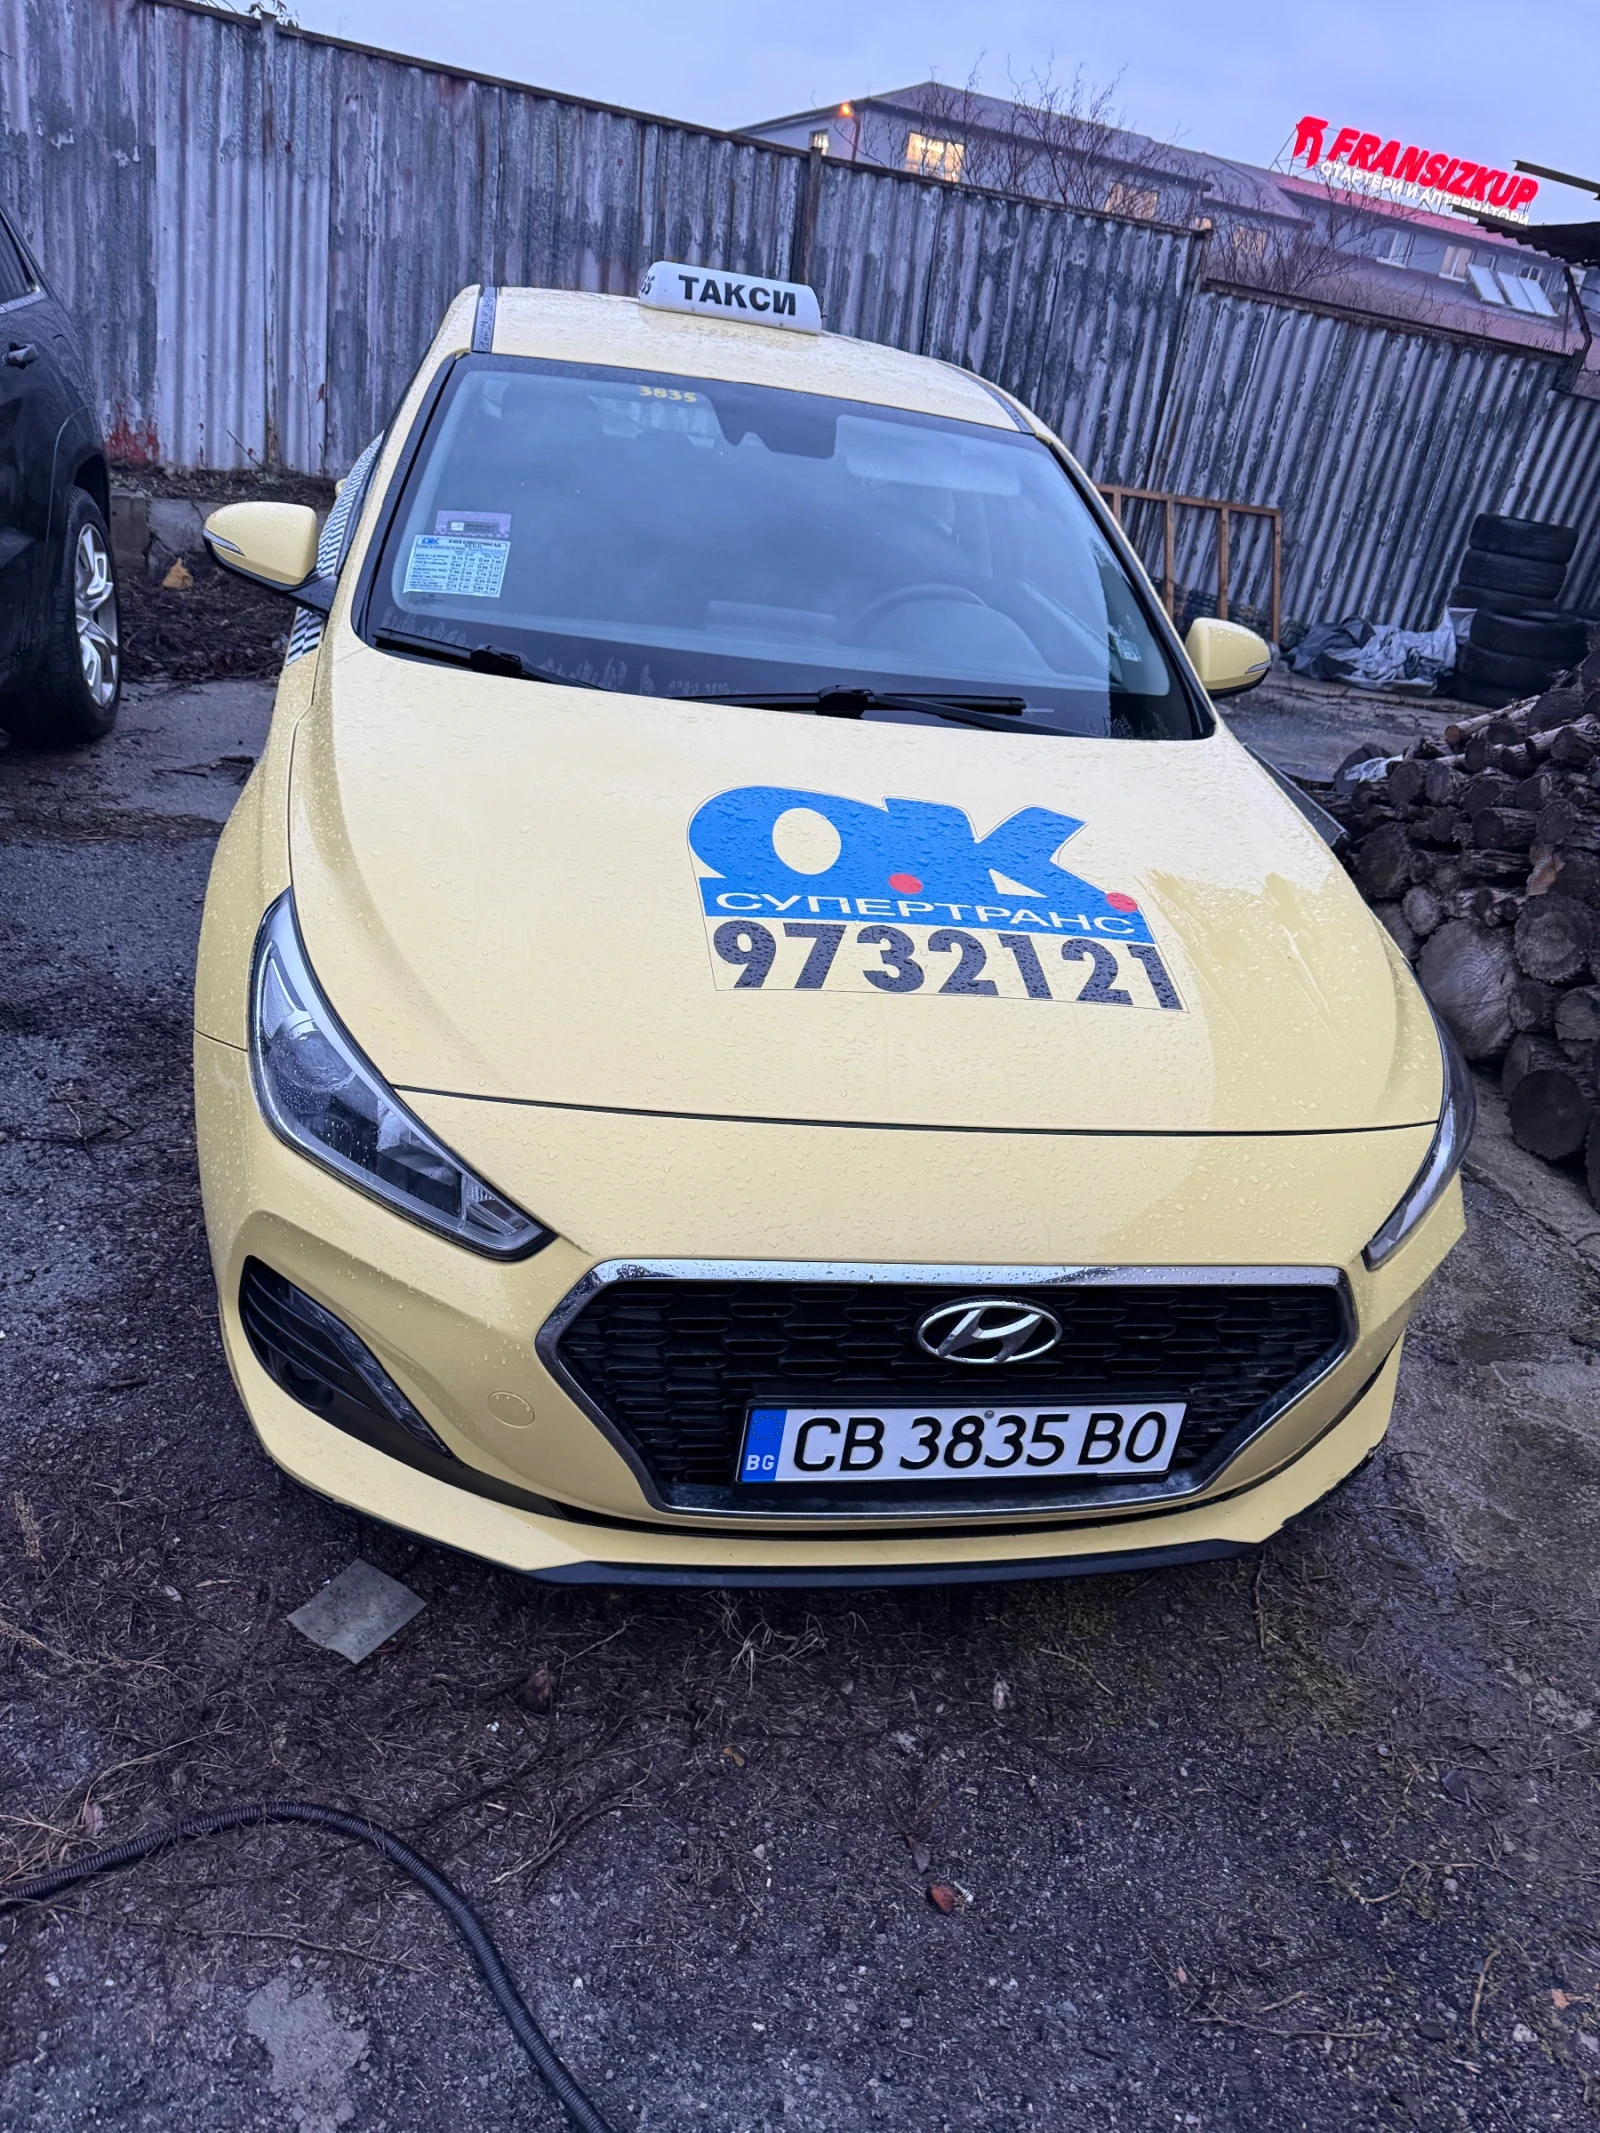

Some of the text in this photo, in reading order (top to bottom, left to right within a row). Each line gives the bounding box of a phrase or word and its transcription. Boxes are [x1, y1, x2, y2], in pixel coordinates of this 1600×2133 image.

[1320, 161, 1402, 195] СТАРТЕРИ
[1405, 184, 1419, 200] И
[1326, 127, 1538, 210] FRANSIZKUP
[678, 274, 796, 316] ТАКСИ
[638, 386, 697, 403] 3835
[715, 892, 1135, 935] СУПЕРТРАНС
[713, 920, 1184, 1010] 9732121
[746, 1454, 774, 1471] BG
[793, 1416, 885, 1472] CB
[899, 1413, 1070, 1470] 3835
